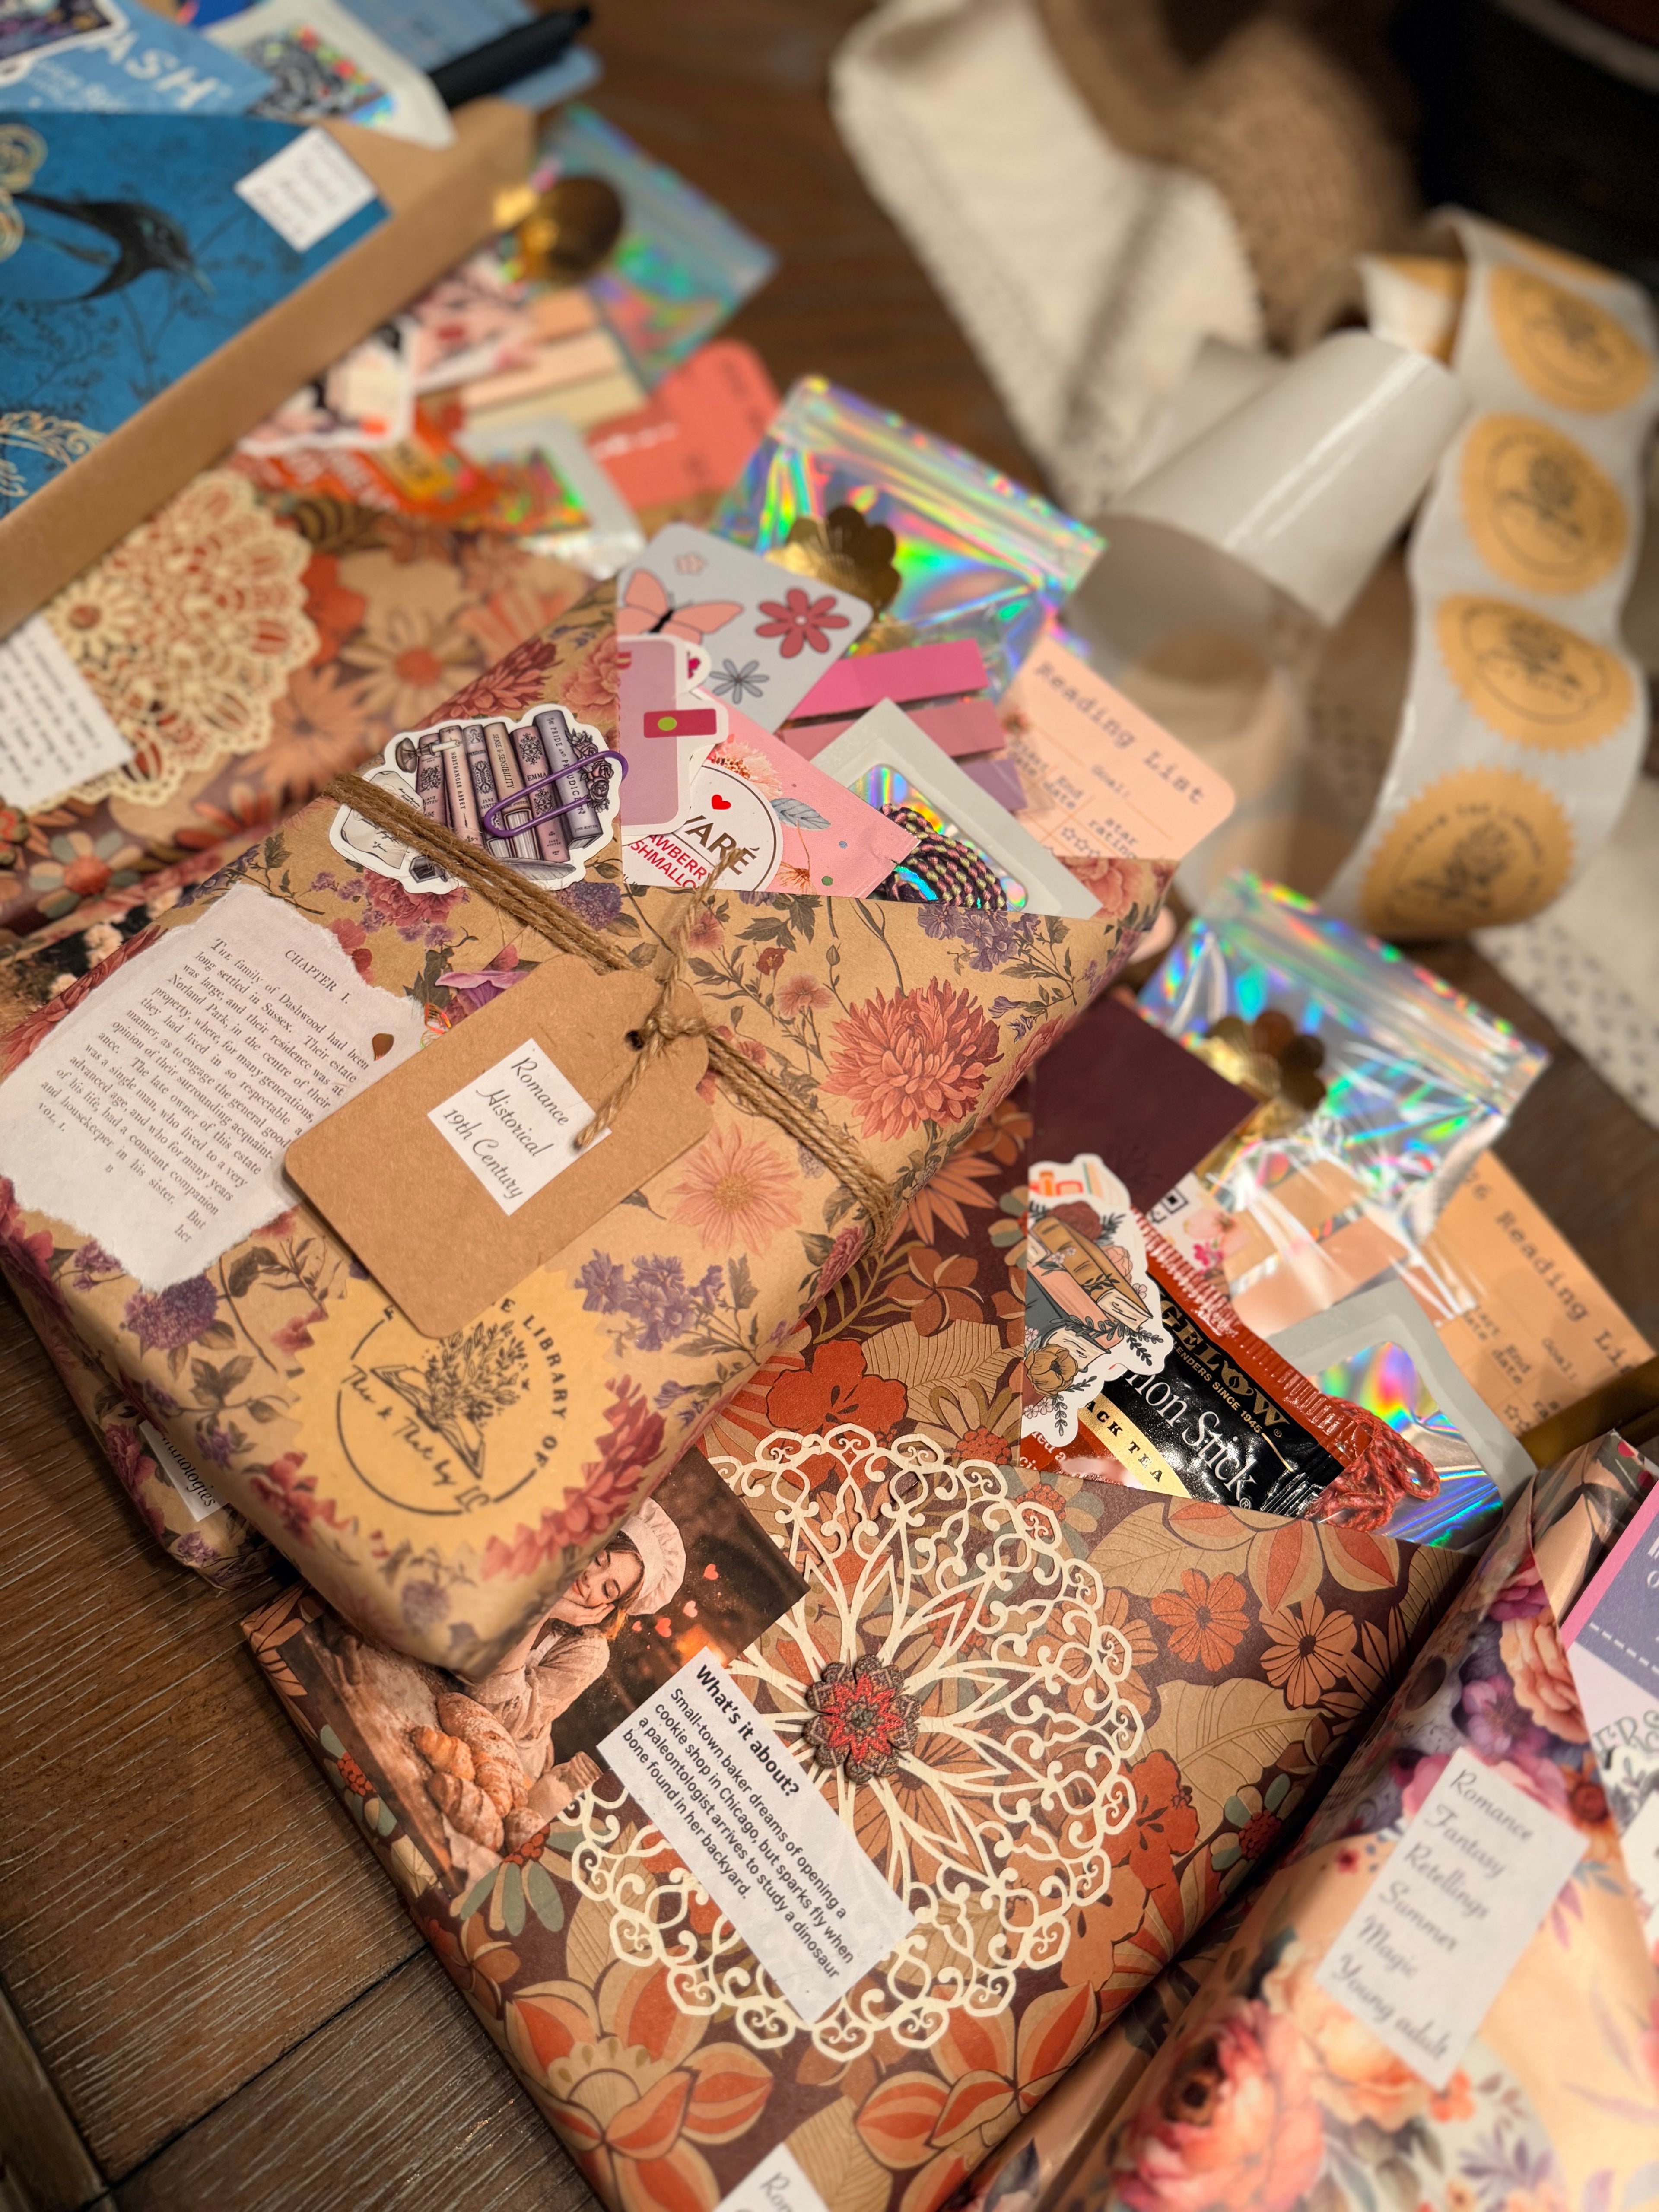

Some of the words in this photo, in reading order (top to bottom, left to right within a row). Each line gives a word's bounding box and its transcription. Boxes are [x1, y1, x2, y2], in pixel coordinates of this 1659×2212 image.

[492, 734, 501, 748] SENSE
[498, 753, 515, 788] SENSIBILITY
[551, 727, 563, 747] PRIDE
[562, 760, 582, 802] PRUDICE
[1033, 661, 1137, 749] Reading
[1143, 750, 1205, 806] List
[527, 772, 548, 782] EMMA
[1043, 781, 1077, 810] date
[195, 951, 217, 971] long
[216, 969, 250, 994] settled
[248, 992, 260, 1004] in
[261, 1002, 292, 1033] Sussex.
[303, 1035, 329, 1060] Their
[329, 1060, 357, 1083] estate
[233, 959, 263, 984] family
[264, 985, 280, 994] of
[278, 993, 327, 1033] Dashwood
[326, 1031, 348, 1050] had
[347, 1048, 369, 1070] been
[284, 950, 337, 992] CHAPTER
[340, 992, 350, 1004] I.
[140, 998, 162, 1016] they
[163, 1014, 184, 1033] had
[184, 1032, 210, 1055] lived
[210, 1053, 222, 1067] in
[224, 1069, 237, 1079] so
[239, 1081, 290, 1125] respectable
[294, 1127, 302, 1136] a
[151, 987, 192, 1021] property,
[194, 1018, 220, 1044] where,
[221, 1040, 238, 1055] for
[236, 1053, 264, 1077] many
[258, 1075, 314, 1123] generations,
[167, 973, 207, 1005] Norland
[204, 1002, 229, 1028] Park,
[230, 1023, 242, 1036] in
[244, 1036, 261, 1050] the
[262, 1052, 292, 1077] centre
[293, 1077, 310, 1088] of
[306, 1087, 331, 1109] their
[183, 964, 200, 979] was
[200, 976, 225, 1001] large,
[225, 998, 247, 1014] and
[245, 1014, 269, 1033] their
[269, 1034, 312, 1069] residence
[312, 1068, 330, 1085] was
[331, 1085, 344, 1096] at
[112, 1021, 144, 1049] opinion
[143, 1048, 160, 1058] of
[155, 1056, 178, 1076] their
[176, 1076, 232, 1126] surrounding
[231, 1123, 274, 1161] acquaint-
[126, 1009, 159, 1040] manner,
[160, 1038, 172, 1049] as
[172, 1047, 184, 1058] to
[182, 1057, 215, 1085] engage
[214, 1083, 231, 1099] the
[227, 1098, 267, 1128] general
[261, 1127, 292, 1149] good
[510, 1056, 569, 1125] Romance
[41, 1081, 63, 1098] and
[59, 1095, 114, 1147] housekeeper
[115, 1145, 127, 1160] in
[129, 1158, 146, 1176] his
[148, 1179, 175, 1205] sister.
[186, 1209, 206, 1230] But
[443, 1109, 482, 1140] 19th
[472, 1138, 523, 1199] Century
[475, 1088, 555, 1157] Historical
[174, 1223, 192, 1243] her
[1495, 1211, 1589, 1323] Reading
[521, 1314, 568, 1420] LIBRARY
[1159, 1292, 1292, 1428] GELOW
[1171, 1344, 1211, 1382] LENDERS
[1211, 1381, 1241, 1411] SINCE
[1240, 1409, 1262, 1436] 1945
[1491, 1349, 1523, 1385] date
[162, 1437, 216, 1508] ologies
[534, 1434, 558, 1469] OF
[1125, 1370, 1188, 1428] non
[1182, 1410, 1258, 1502] Stick
[1127, 1440, 1166, 1484] TEA
[639, 1717, 648, 1728] a
[696, 1664, 741, 1724] What's
[737, 1721, 753, 1741] it
[749, 1740, 799, 1796] about?
[643, 1726, 715, 1815] paleontologist
[670, 1688, 724, 1759] Small-town
[720, 1754, 752, 1792] baker
[749, 1793, 788, 1842] dreams
[785, 1841, 803, 1856] of
[796, 1856, 839, 1910] opening
[836, 1907, 846, 1919] a
[1449, 1767, 1534, 1842] Romance
[622, 1728, 649, 1763] bone
[646, 1761, 680, 1801] found
[673, 1796, 687, 1815] in
[683, 1810, 705, 1835] her
[700, 1833, 751, 1899] backyard.
[655, 1703, 687, 1745] cookie
[684, 1744, 711, 1775] shop
[708, 1772, 721, 1790] in
[719, 1787, 759, 1843] Chicago,
[757, 1838, 780, 1866] but
[775, 1864, 812, 1909] sparks
[809, 1906, 827, 1927] fly
[823, 1925, 853, 1964] when
[711, 1813, 748, 1859] arrives
[1423, 1802, 1508, 1879] Fantasy
[745, 1857, 759, 1875] to
[756, 1874, 788, 1912] study
[1402, 1841, 1490, 1921] Retellings
[784, 1911, 795, 1922] a
[792, 1921, 839, 1978] dinosaur
[1357, 1913, 1419, 1981] Magic
[1378, 1879, 1459, 1954] Summer
[1331, 1952, 1396, 2022] Young
[1394, 2015, 1450, 2061] adult
